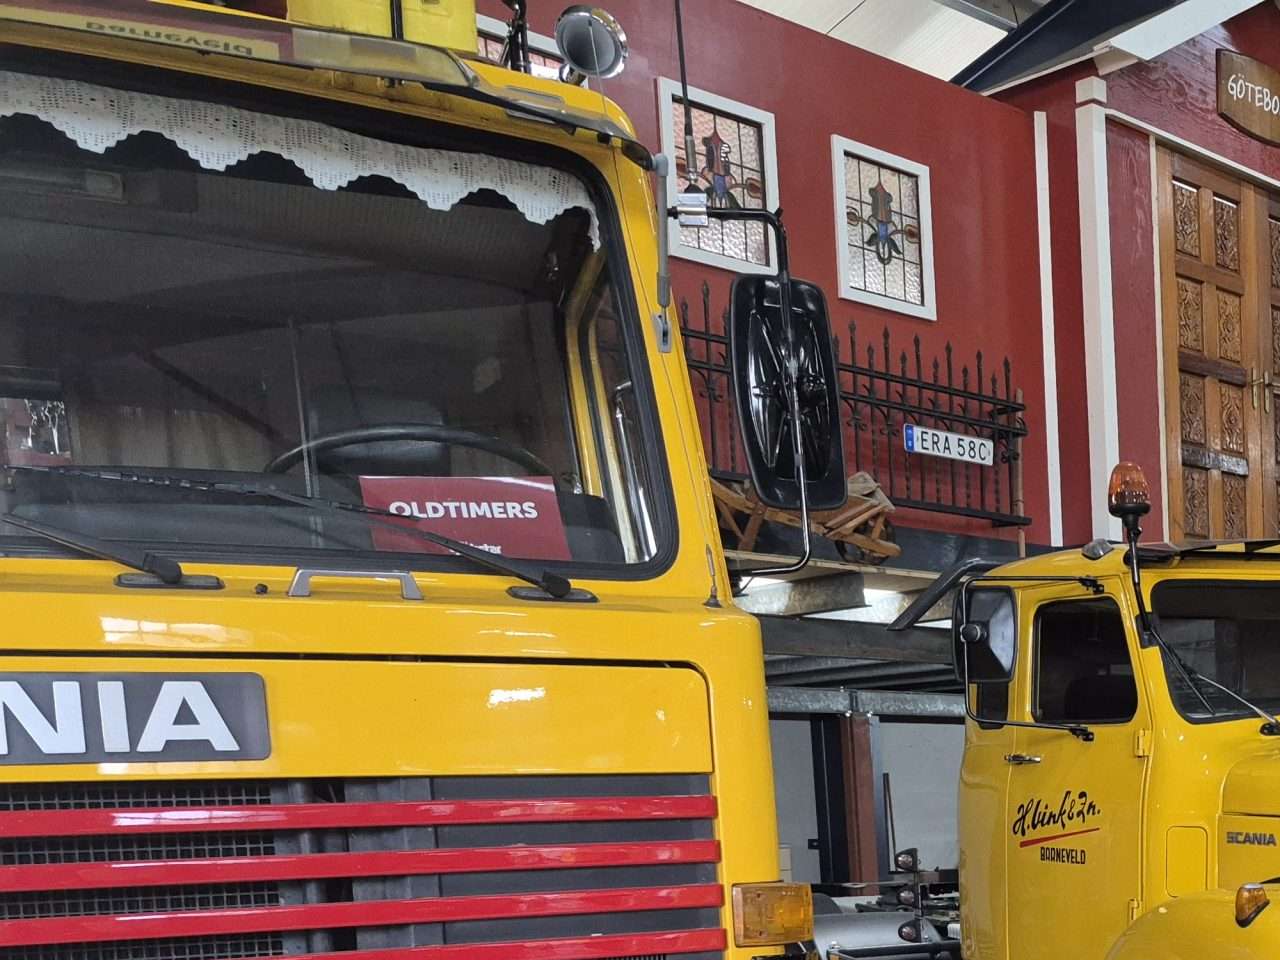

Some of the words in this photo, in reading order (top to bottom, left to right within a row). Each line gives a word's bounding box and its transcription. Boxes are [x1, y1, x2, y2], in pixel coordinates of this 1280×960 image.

[920, 431, 952, 455] ERA
[389, 501, 538, 518] OLDTIMERS
[1226, 831, 1277, 846] SCANIA
[1040, 846, 1086, 864] BARNEVELD
